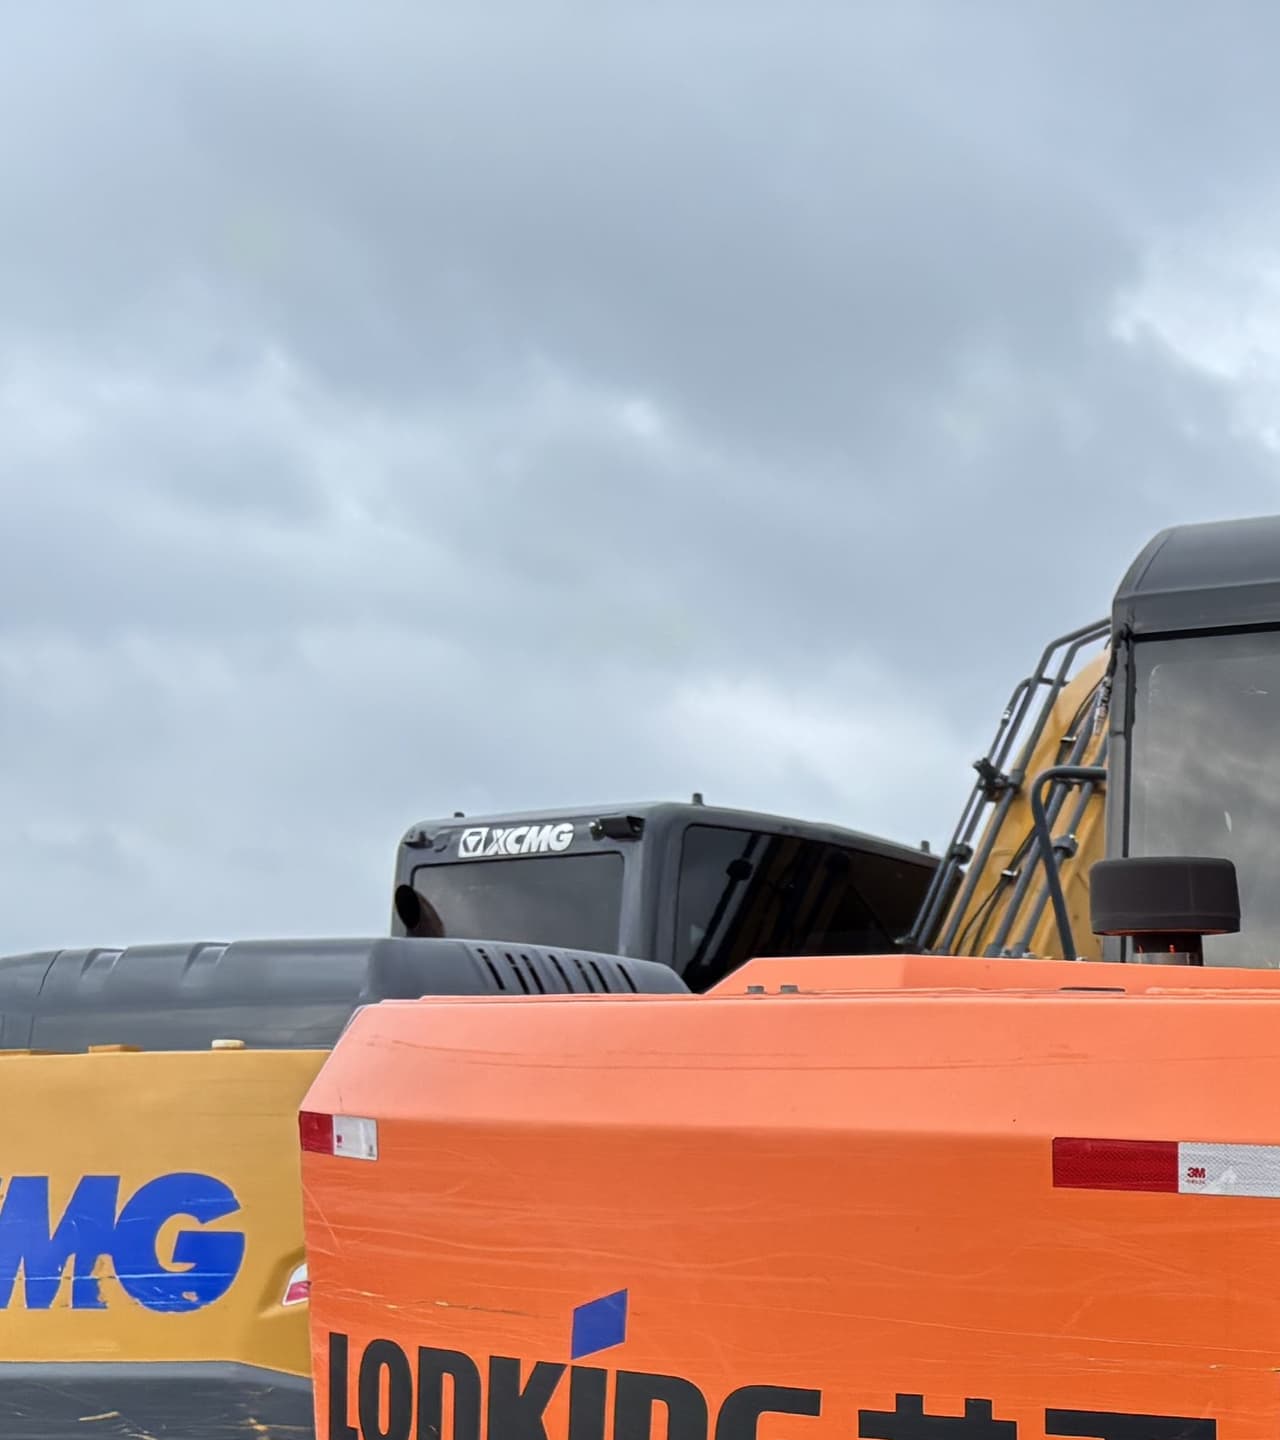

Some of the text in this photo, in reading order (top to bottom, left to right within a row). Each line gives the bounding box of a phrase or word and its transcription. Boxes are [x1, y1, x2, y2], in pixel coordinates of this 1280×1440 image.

[483, 823, 574, 856] XCMG
[1187, 1167, 1206, 1178] 3M
[0, 1172, 246, 1314] MG
